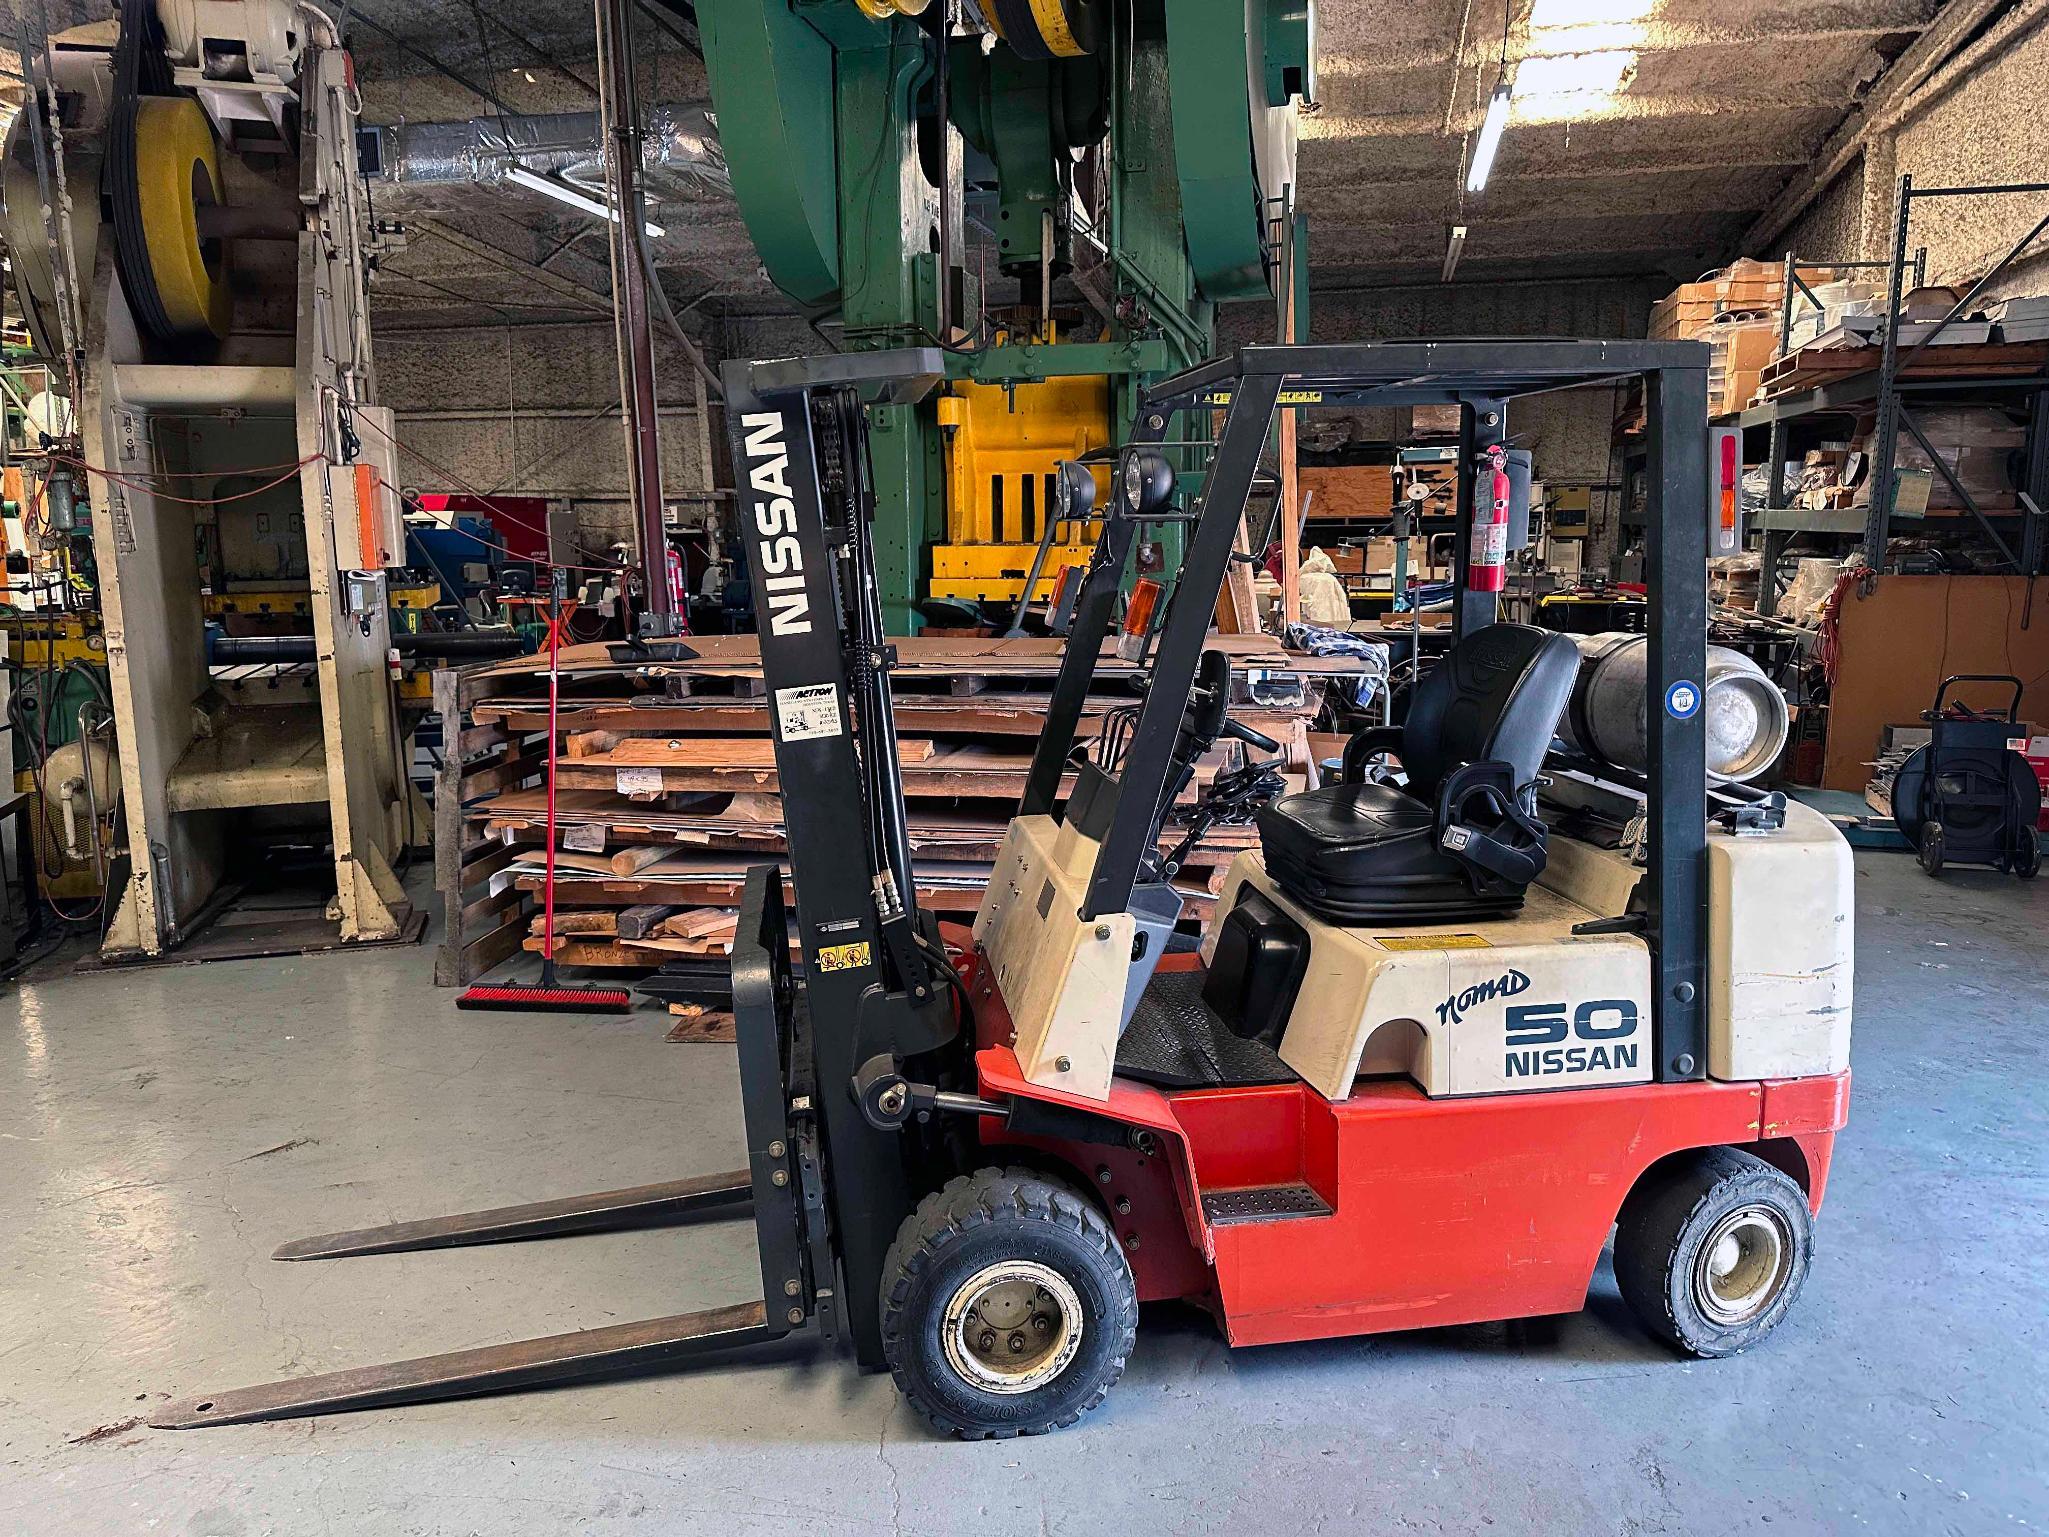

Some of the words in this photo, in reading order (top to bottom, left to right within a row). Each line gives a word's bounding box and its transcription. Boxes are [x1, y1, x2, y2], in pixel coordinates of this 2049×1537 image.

[741, 411, 812, 637] NISSAN
[583, 944, 631, 961] BRONZE
[1505, 999, 1638, 1046] 50
[1505, 1044, 1638, 1078] NISSAN
